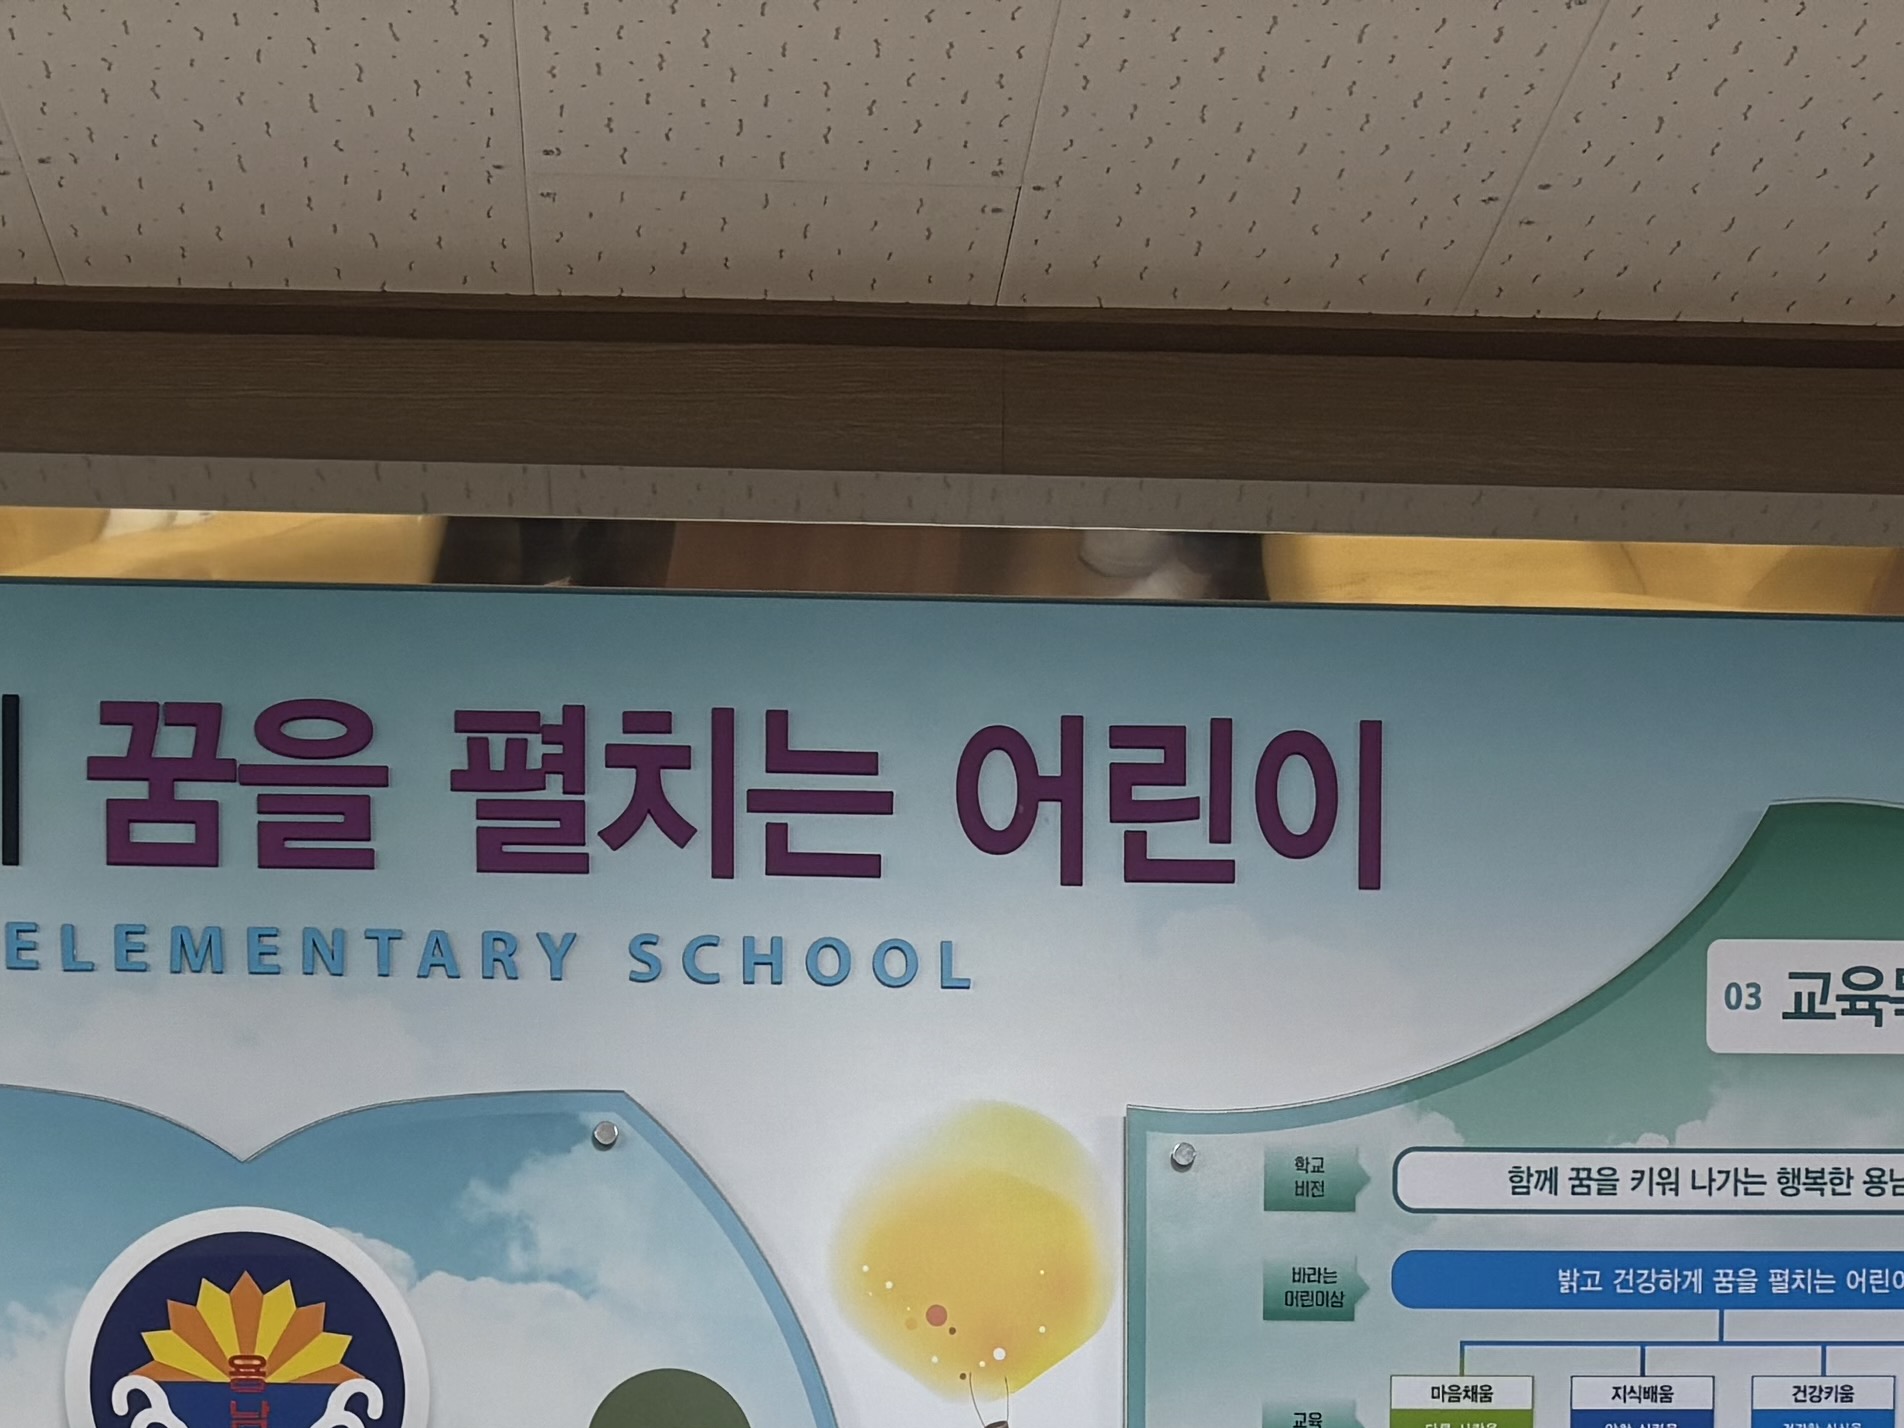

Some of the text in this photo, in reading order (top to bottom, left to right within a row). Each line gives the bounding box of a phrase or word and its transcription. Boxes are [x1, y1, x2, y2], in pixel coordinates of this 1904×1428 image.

[86, 699, 389, 870] 꿈을
[450, 704, 894, 879] 펼치는
[956, 715, 1382, 890] 어린이
[5, 921, 580, 981] ELEMENTARY
[628, 933, 971, 990] SCHOOL
[1724, 982, 1762, 1010] 03
[1293, 1155, 1326, 1175] 학교
[1293, 1179, 1326, 1198] 비전
[1508, 1166, 1558, 1196] 함께
[1568, 1167, 1620, 1196] 꿈을
[1631, 1167, 1679, 1197] 키워
[1691, 1167, 1767, 1197] 나가는
[1777, 1167, 1854, 1197] 행복한
[1292, 1267, 1337, 1284] 바라는
[1558, 1268, 1603, 1294] 밝고
[1613, 1268, 1702, 1294] 건강하게
[1712, 1268, 1758, 1293] 꿈을
[1768, 1268, 1836, 1294] 펼치는
[1284, 1290, 1346, 1309] 어린이상
[1431, 1384, 1494, 1403] 마음채움
[1611, 1385, 1674, 1404] 지식배움
[1792, 1384, 1855, 1403] 건강키움
